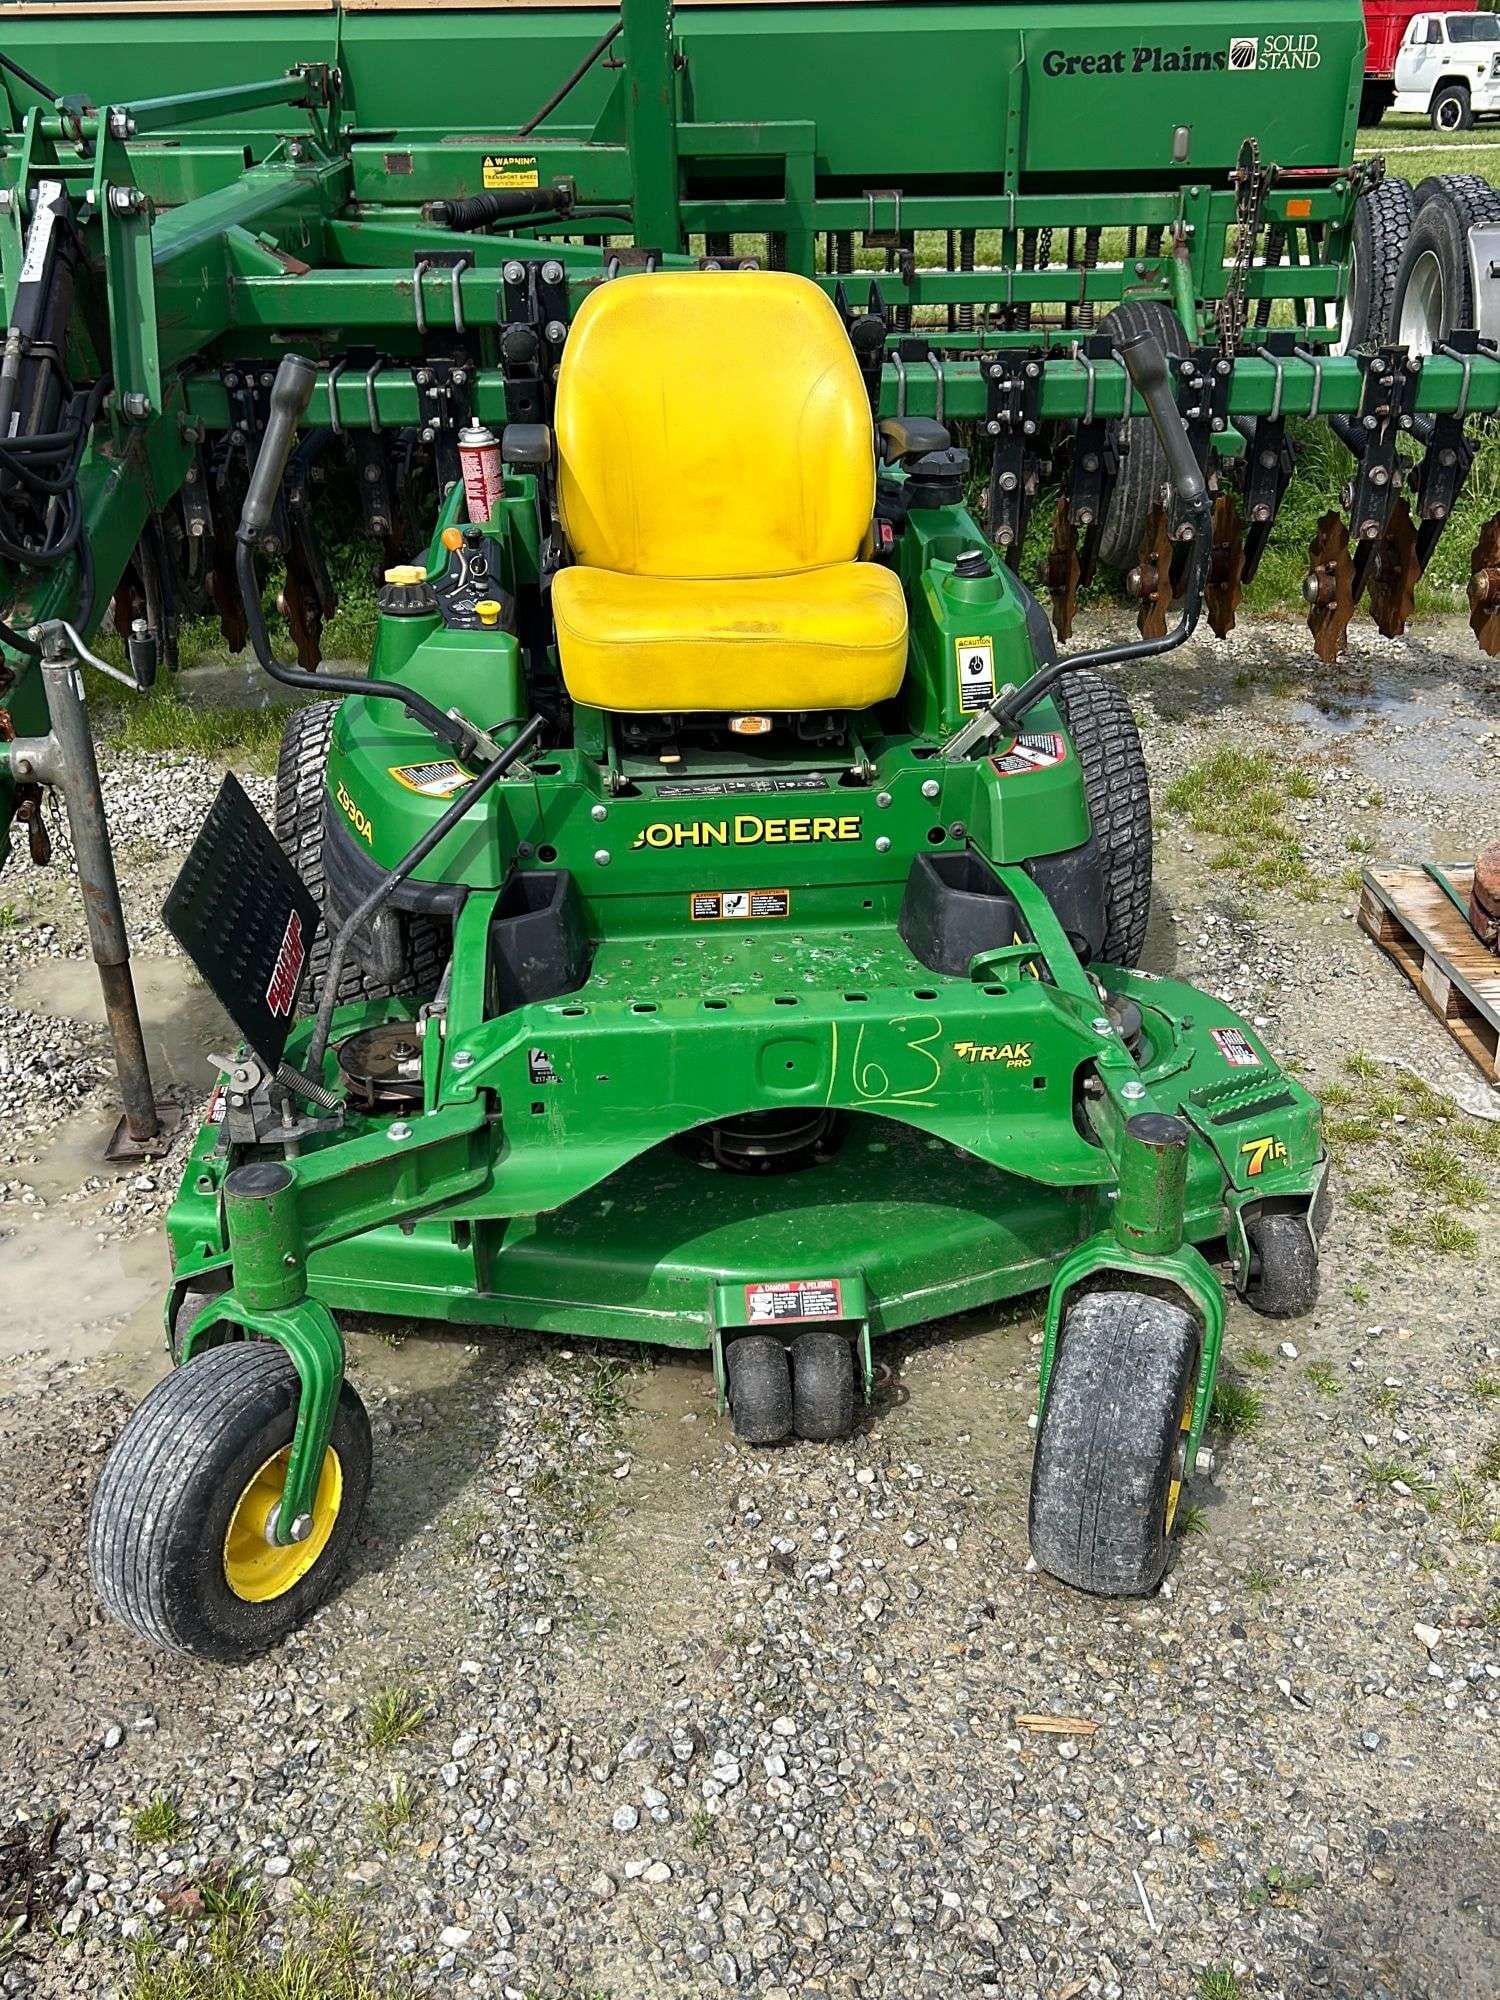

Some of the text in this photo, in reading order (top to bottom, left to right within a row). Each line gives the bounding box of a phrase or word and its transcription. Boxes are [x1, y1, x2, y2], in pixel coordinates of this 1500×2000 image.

[1263, 34, 1318, 53] SOLID
[1043, 45, 1227, 77] Great Plains
[1257, 51, 1321, 71] STAND
[494, 157, 537, 166] WARNING
[335, 780, 374, 848] Z930A
[734, 815, 862, 844] DEERE
[825, 1014, 942, 1106] 163
[1006, 1058, 1033, 1069] PRO
